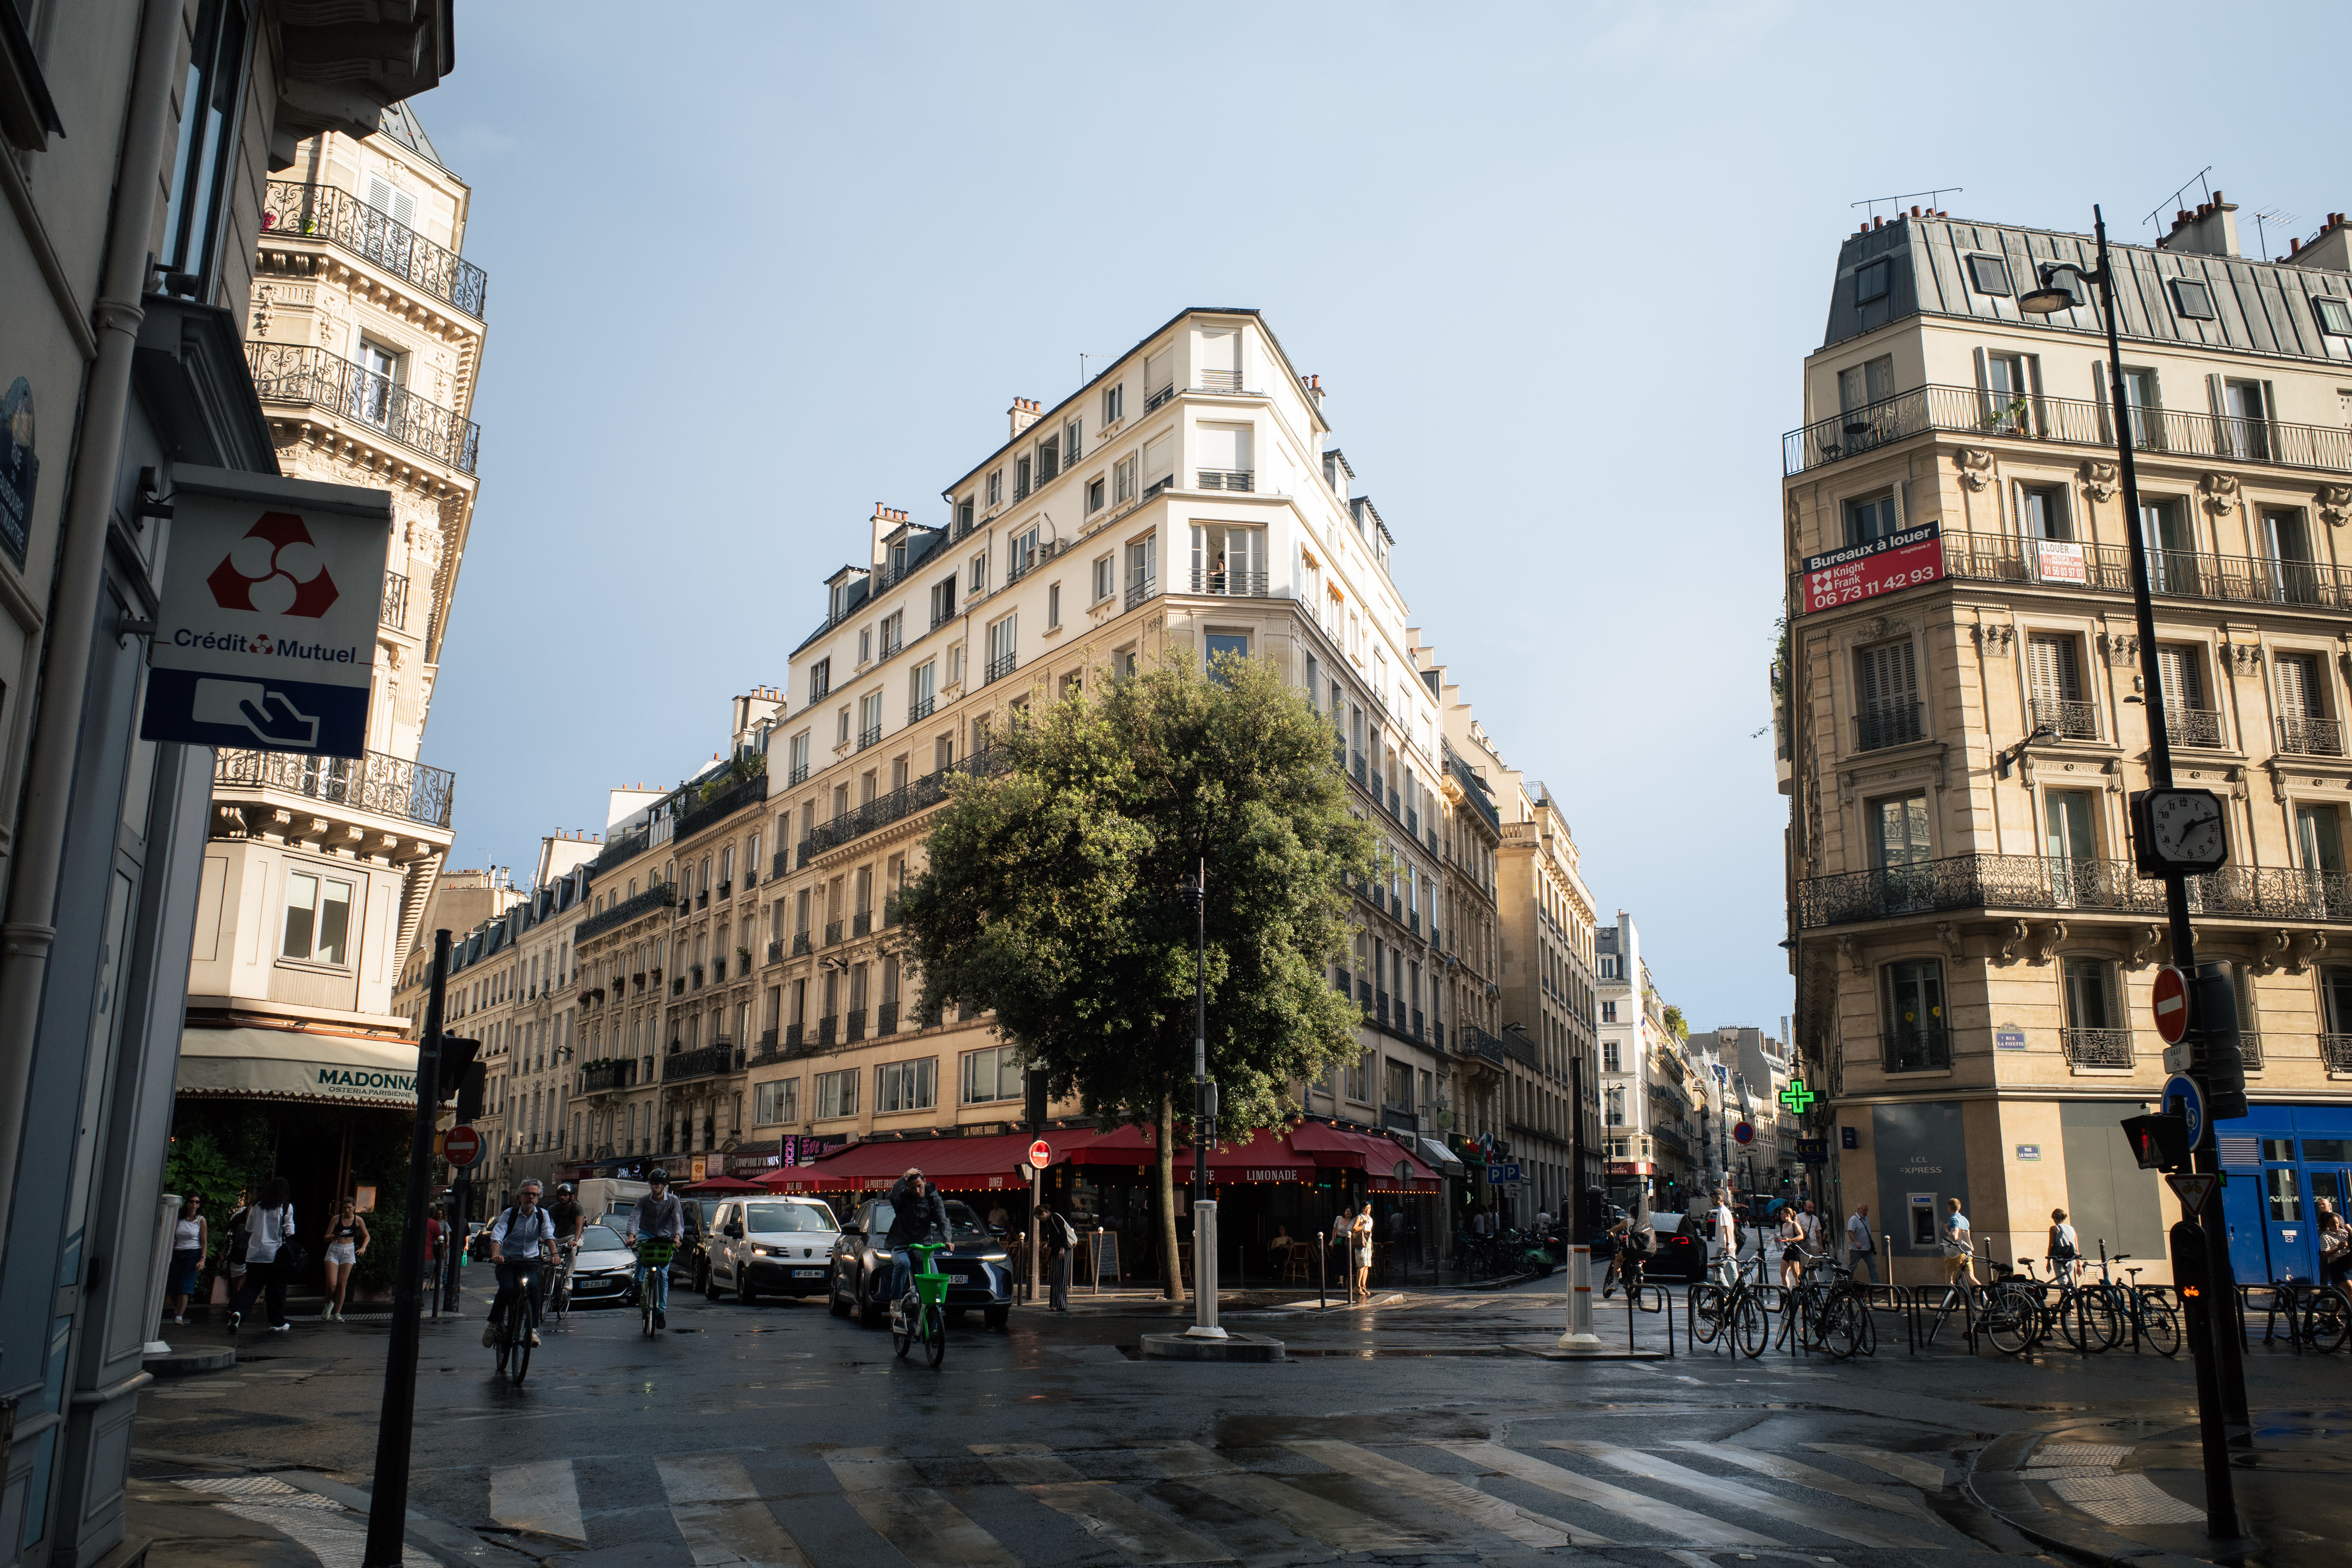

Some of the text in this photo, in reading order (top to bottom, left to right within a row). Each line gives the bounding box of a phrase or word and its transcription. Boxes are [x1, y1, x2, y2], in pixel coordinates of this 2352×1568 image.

[11, 442, 22, 470] RUE
[0, 472, 24, 520] AUBOURG
[1810, 528, 1931, 570] Bureaux à louer
[1900, 543, 1932, 554] knightfrank.fr
[2040, 543, 2045, 551] A
[2046, 544, 2069, 554] LOUER
[1833, 561, 1865, 578] Knight
[2044, 565, 2083, 577] 01 56 03 97 07
[1815, 566, 1934, 608] 06 73 11 42 93
[1834, 574, 1861, 589] Frank
[173, 628, 356, 664] Crédit Mutuel
[2169, 802, 2176, 810] 11
[2179, 798, 2188, 807] 12
[2161, 811, 2169, 819] 10
[2159, 823, 2164, 831] 9
[2209, 824, 2215, 833] 3
[2164, 835, 2170, 844] 8
[2175, 844, 2180, 852] 7
[2199, 845, 2204, 854] 5
[2170, 1047, 2181, 1057] SAUF
[329, 1086, 412, 1098] OSTERIA PARISIENNE
[964, 1125, 998, 1136] LA POINTE DROUOT
[801, 1138, 820, 1154] Eve
[736, 1155, 779, 1168] COMPTOIR D'ACHATS
[1246, 1169, 1297, 1181] LIMONADE
[1492, 1169, 1499, 1181] P
[1508, 1167, 1515, 1178] P
[787, 1182, 802, 1191] DEJENER
[865, 1179, 870, 1188] LA
[870, 1179, 883, 1188] POINTE
[989, 1176, 1003, 1187] DINER
